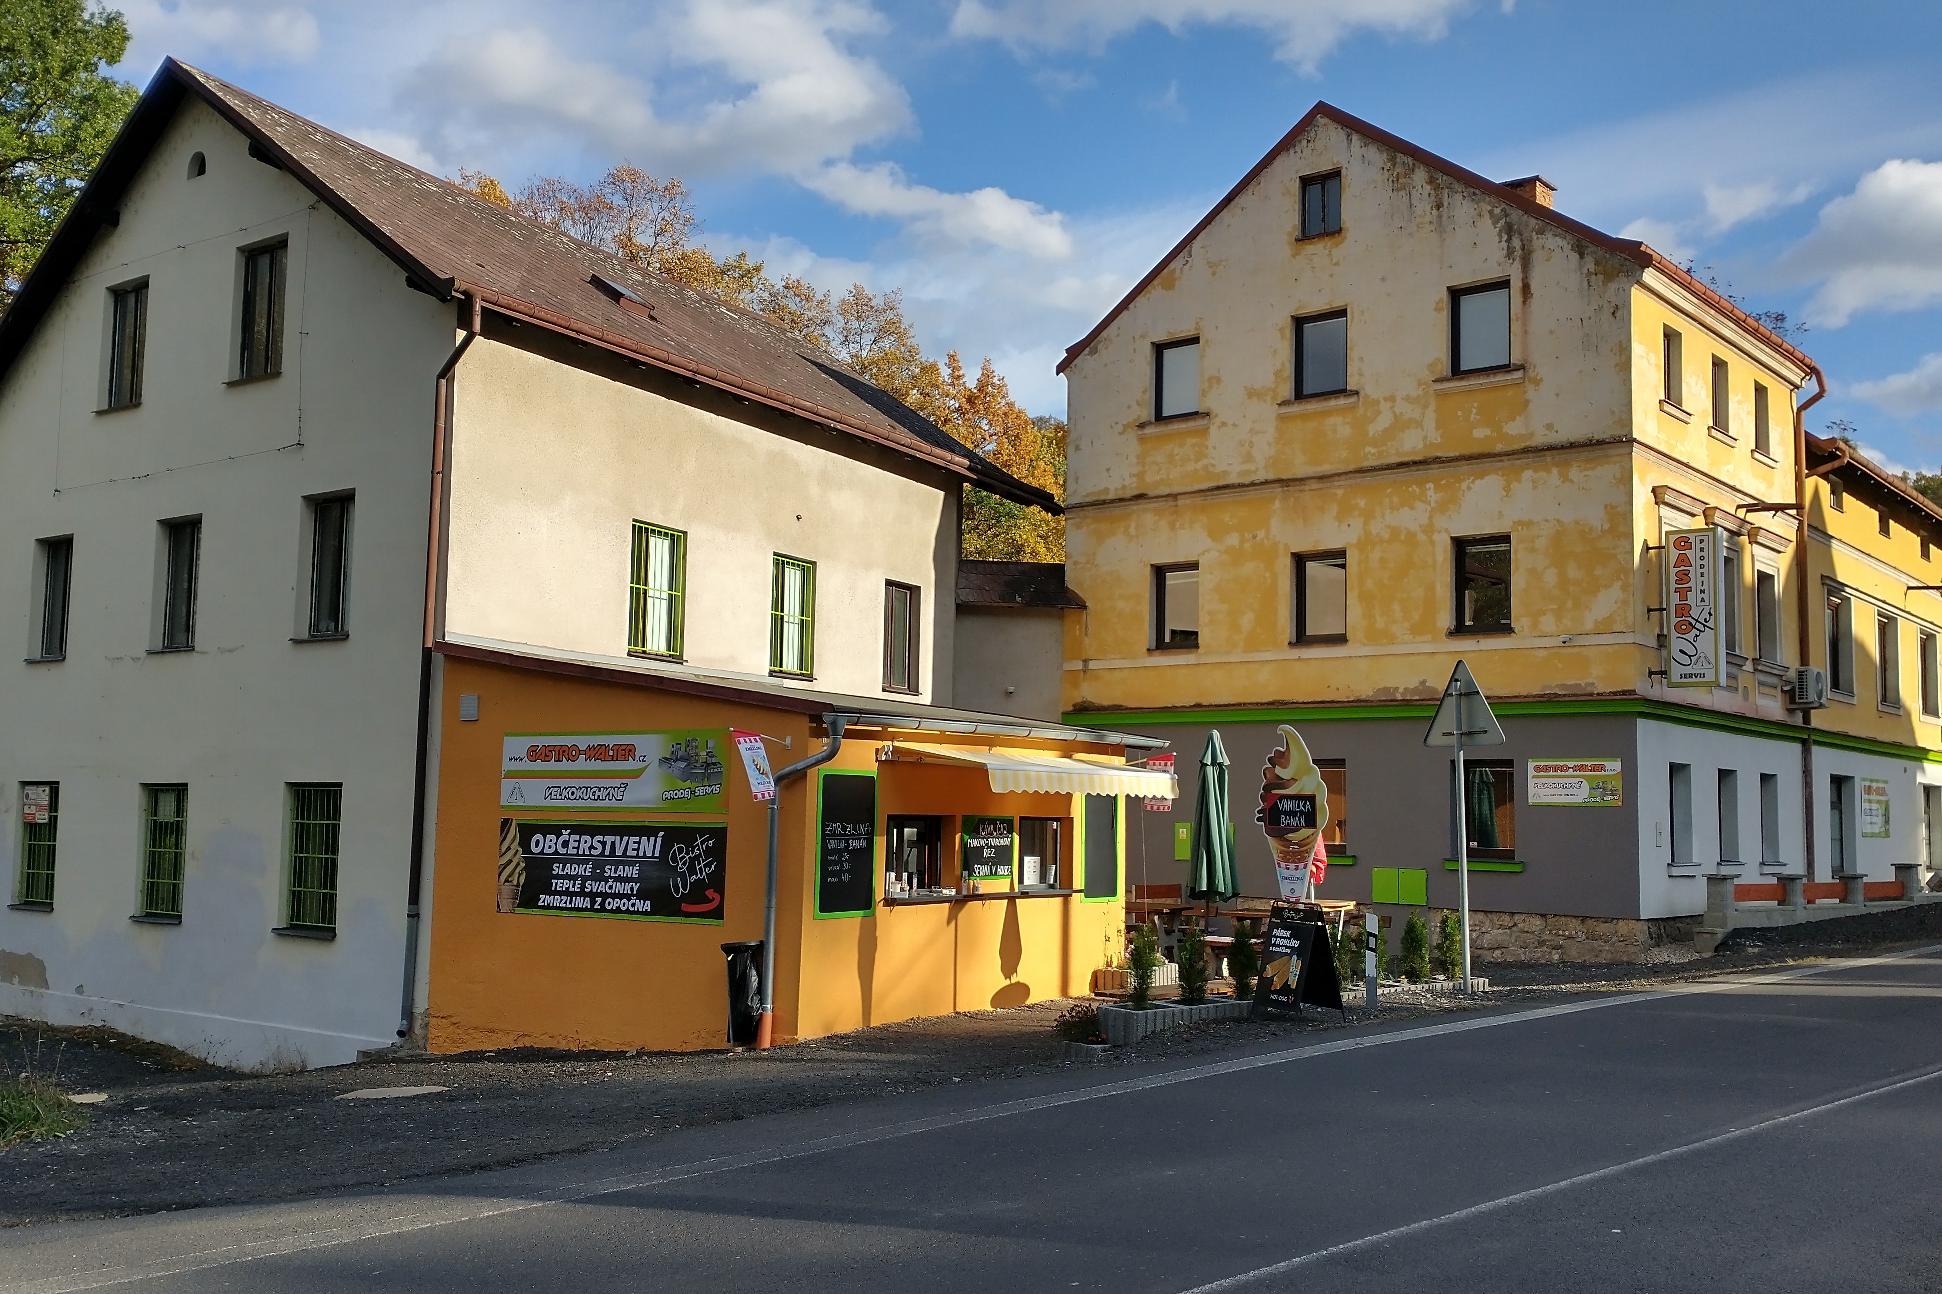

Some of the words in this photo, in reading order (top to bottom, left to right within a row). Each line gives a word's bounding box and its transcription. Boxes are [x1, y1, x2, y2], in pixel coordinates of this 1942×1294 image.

[1672, 535, 1694, 635] GASTRO
[1679, 672, 1706, 680] SERVIS
[544, 783, 628, 801] VELKOKUCHYNĚ
[1276, 796, 1313, 812] VANILKA
[825, 822, 872, 835] ZMRZLINA
[1280, 813, 1306, 827] BANÁN
[530, 829, 665, 857] OBČERSTVENÍ
[669, 833, 716, 872] Bistro
[551, 862, 593, 876] SLADKÉ
[604, 864, 640, 878] SLANÉ
[669, 857, 718, 898] Walter
[551, 878, 582, 892] TEPLÉ
[584, 879, 641, 895] SVAČINKY
[538, 894, 591, 909] ZMRZLINA
[595, 898, 602, 909] Z
[604, 896, 651, 912] OPOČNA
